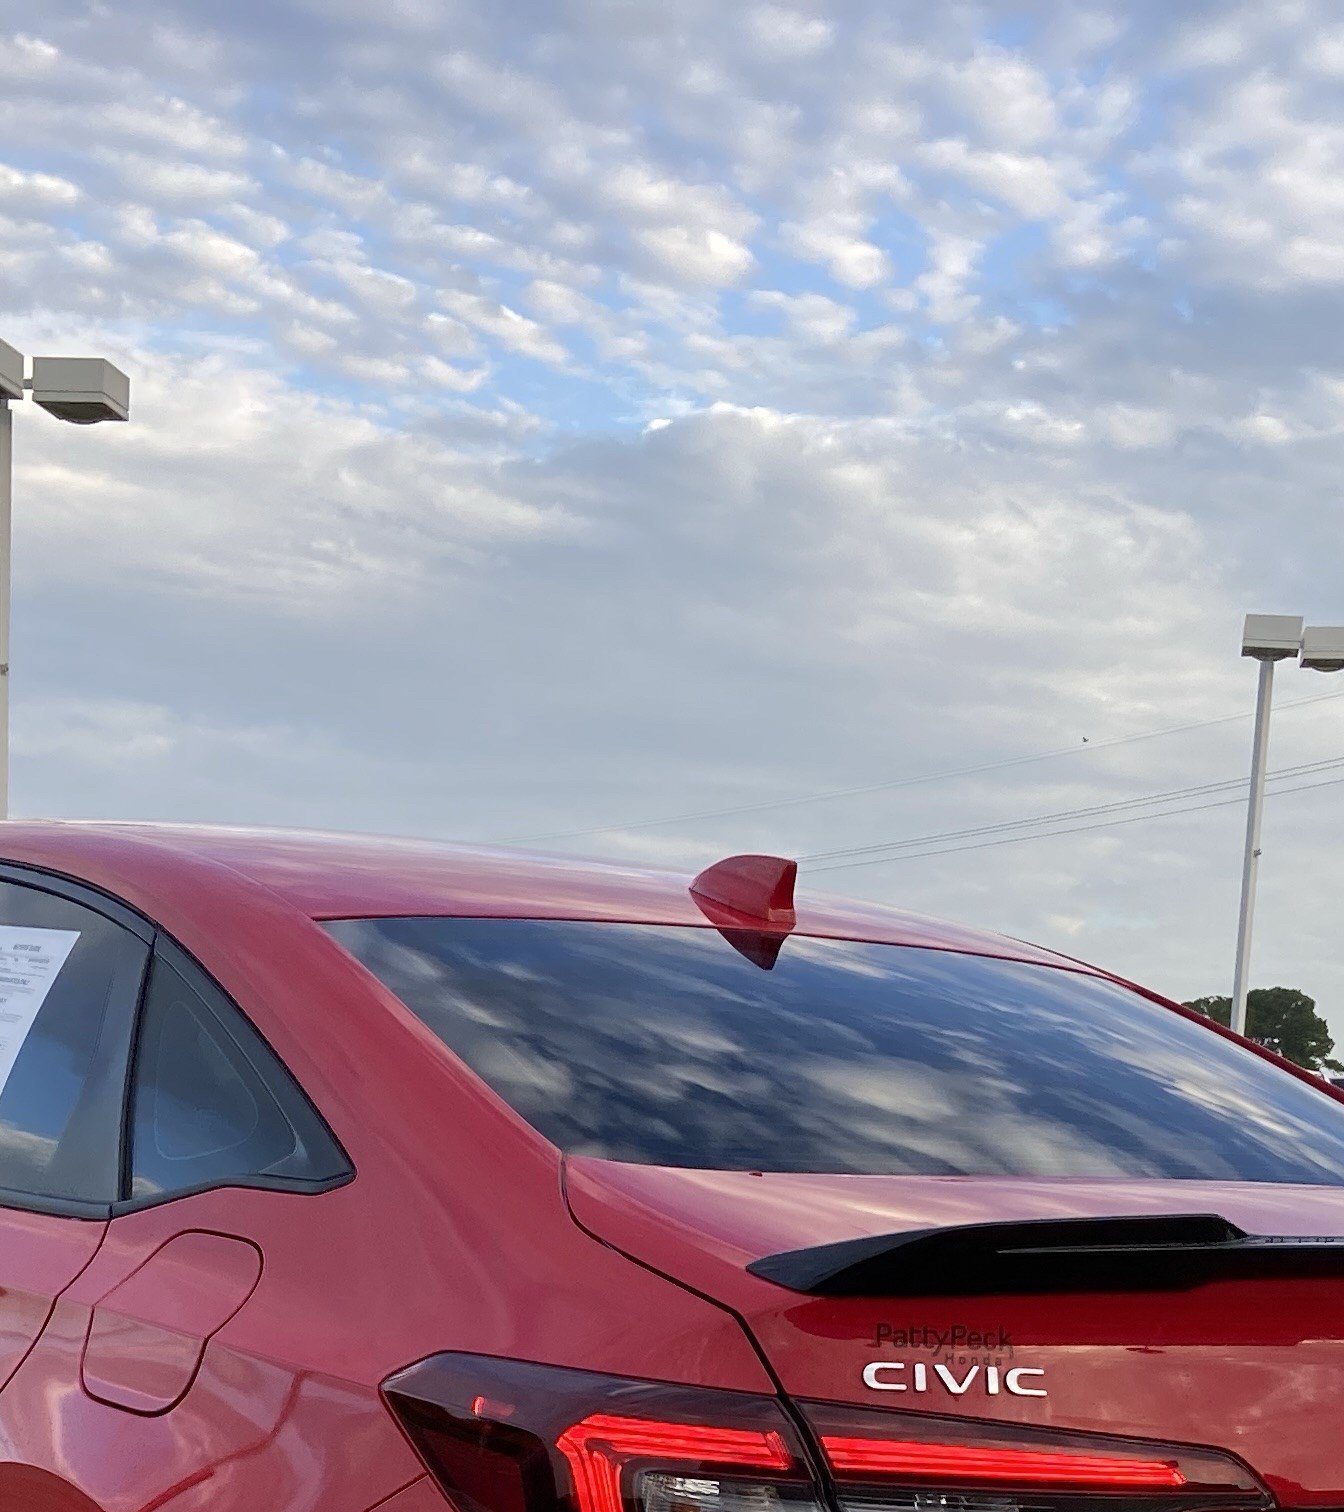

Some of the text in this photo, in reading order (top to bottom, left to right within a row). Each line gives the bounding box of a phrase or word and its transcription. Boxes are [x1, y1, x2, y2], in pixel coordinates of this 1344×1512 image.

[876, 1323, 1014, 1359] PattyPeck
[945, 1353, 1002, 1366] Honda
[863, 1362, 1048, 1397] CIVIC
